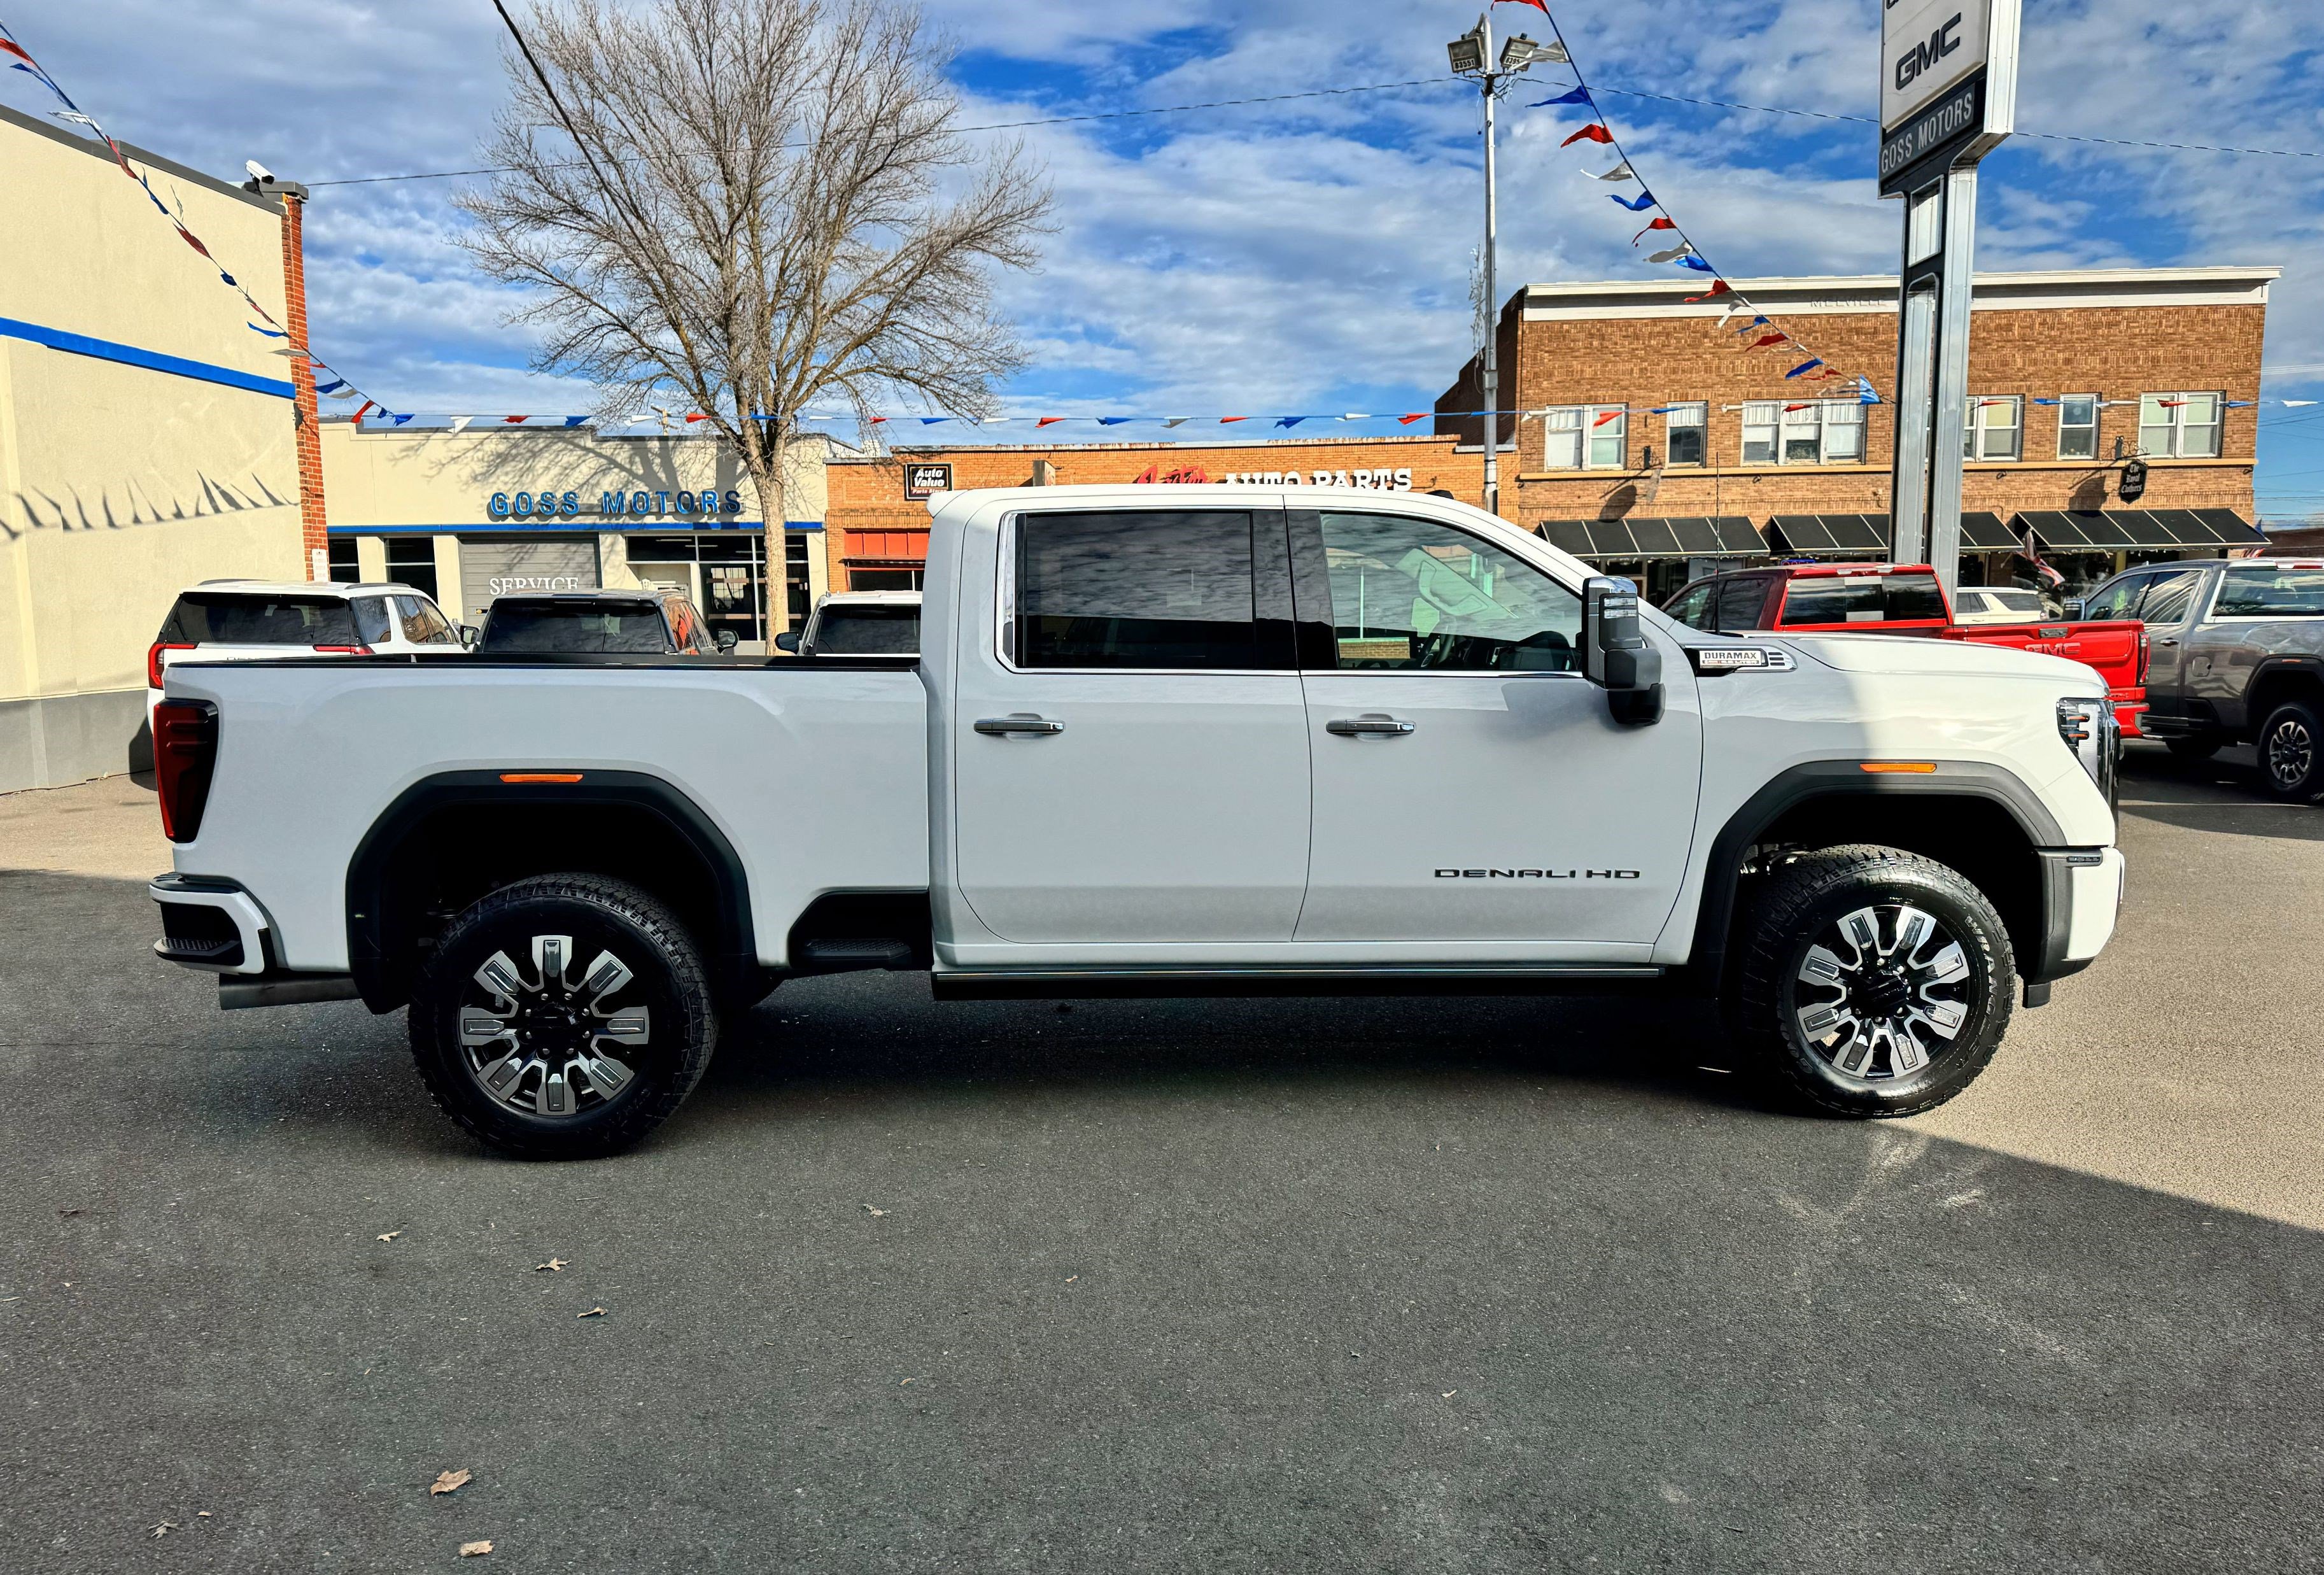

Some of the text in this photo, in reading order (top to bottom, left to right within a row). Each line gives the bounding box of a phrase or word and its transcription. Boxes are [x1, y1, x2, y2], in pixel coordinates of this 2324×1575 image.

[1896, 12, 1961, 90] GMC
[1881, 92, 1973, 173] GOSS MOTORS
[915, 468, 943, 477] Auto
[1313, 468, 1412, 492] PARTS
[490, 490, 742, 516] GOSS MOTORS
[489, 577, 579, 595] SERVICE
[2024, 642, 2081, 655] GMC
[1434, 868, 1640, 879] DENALI HD
